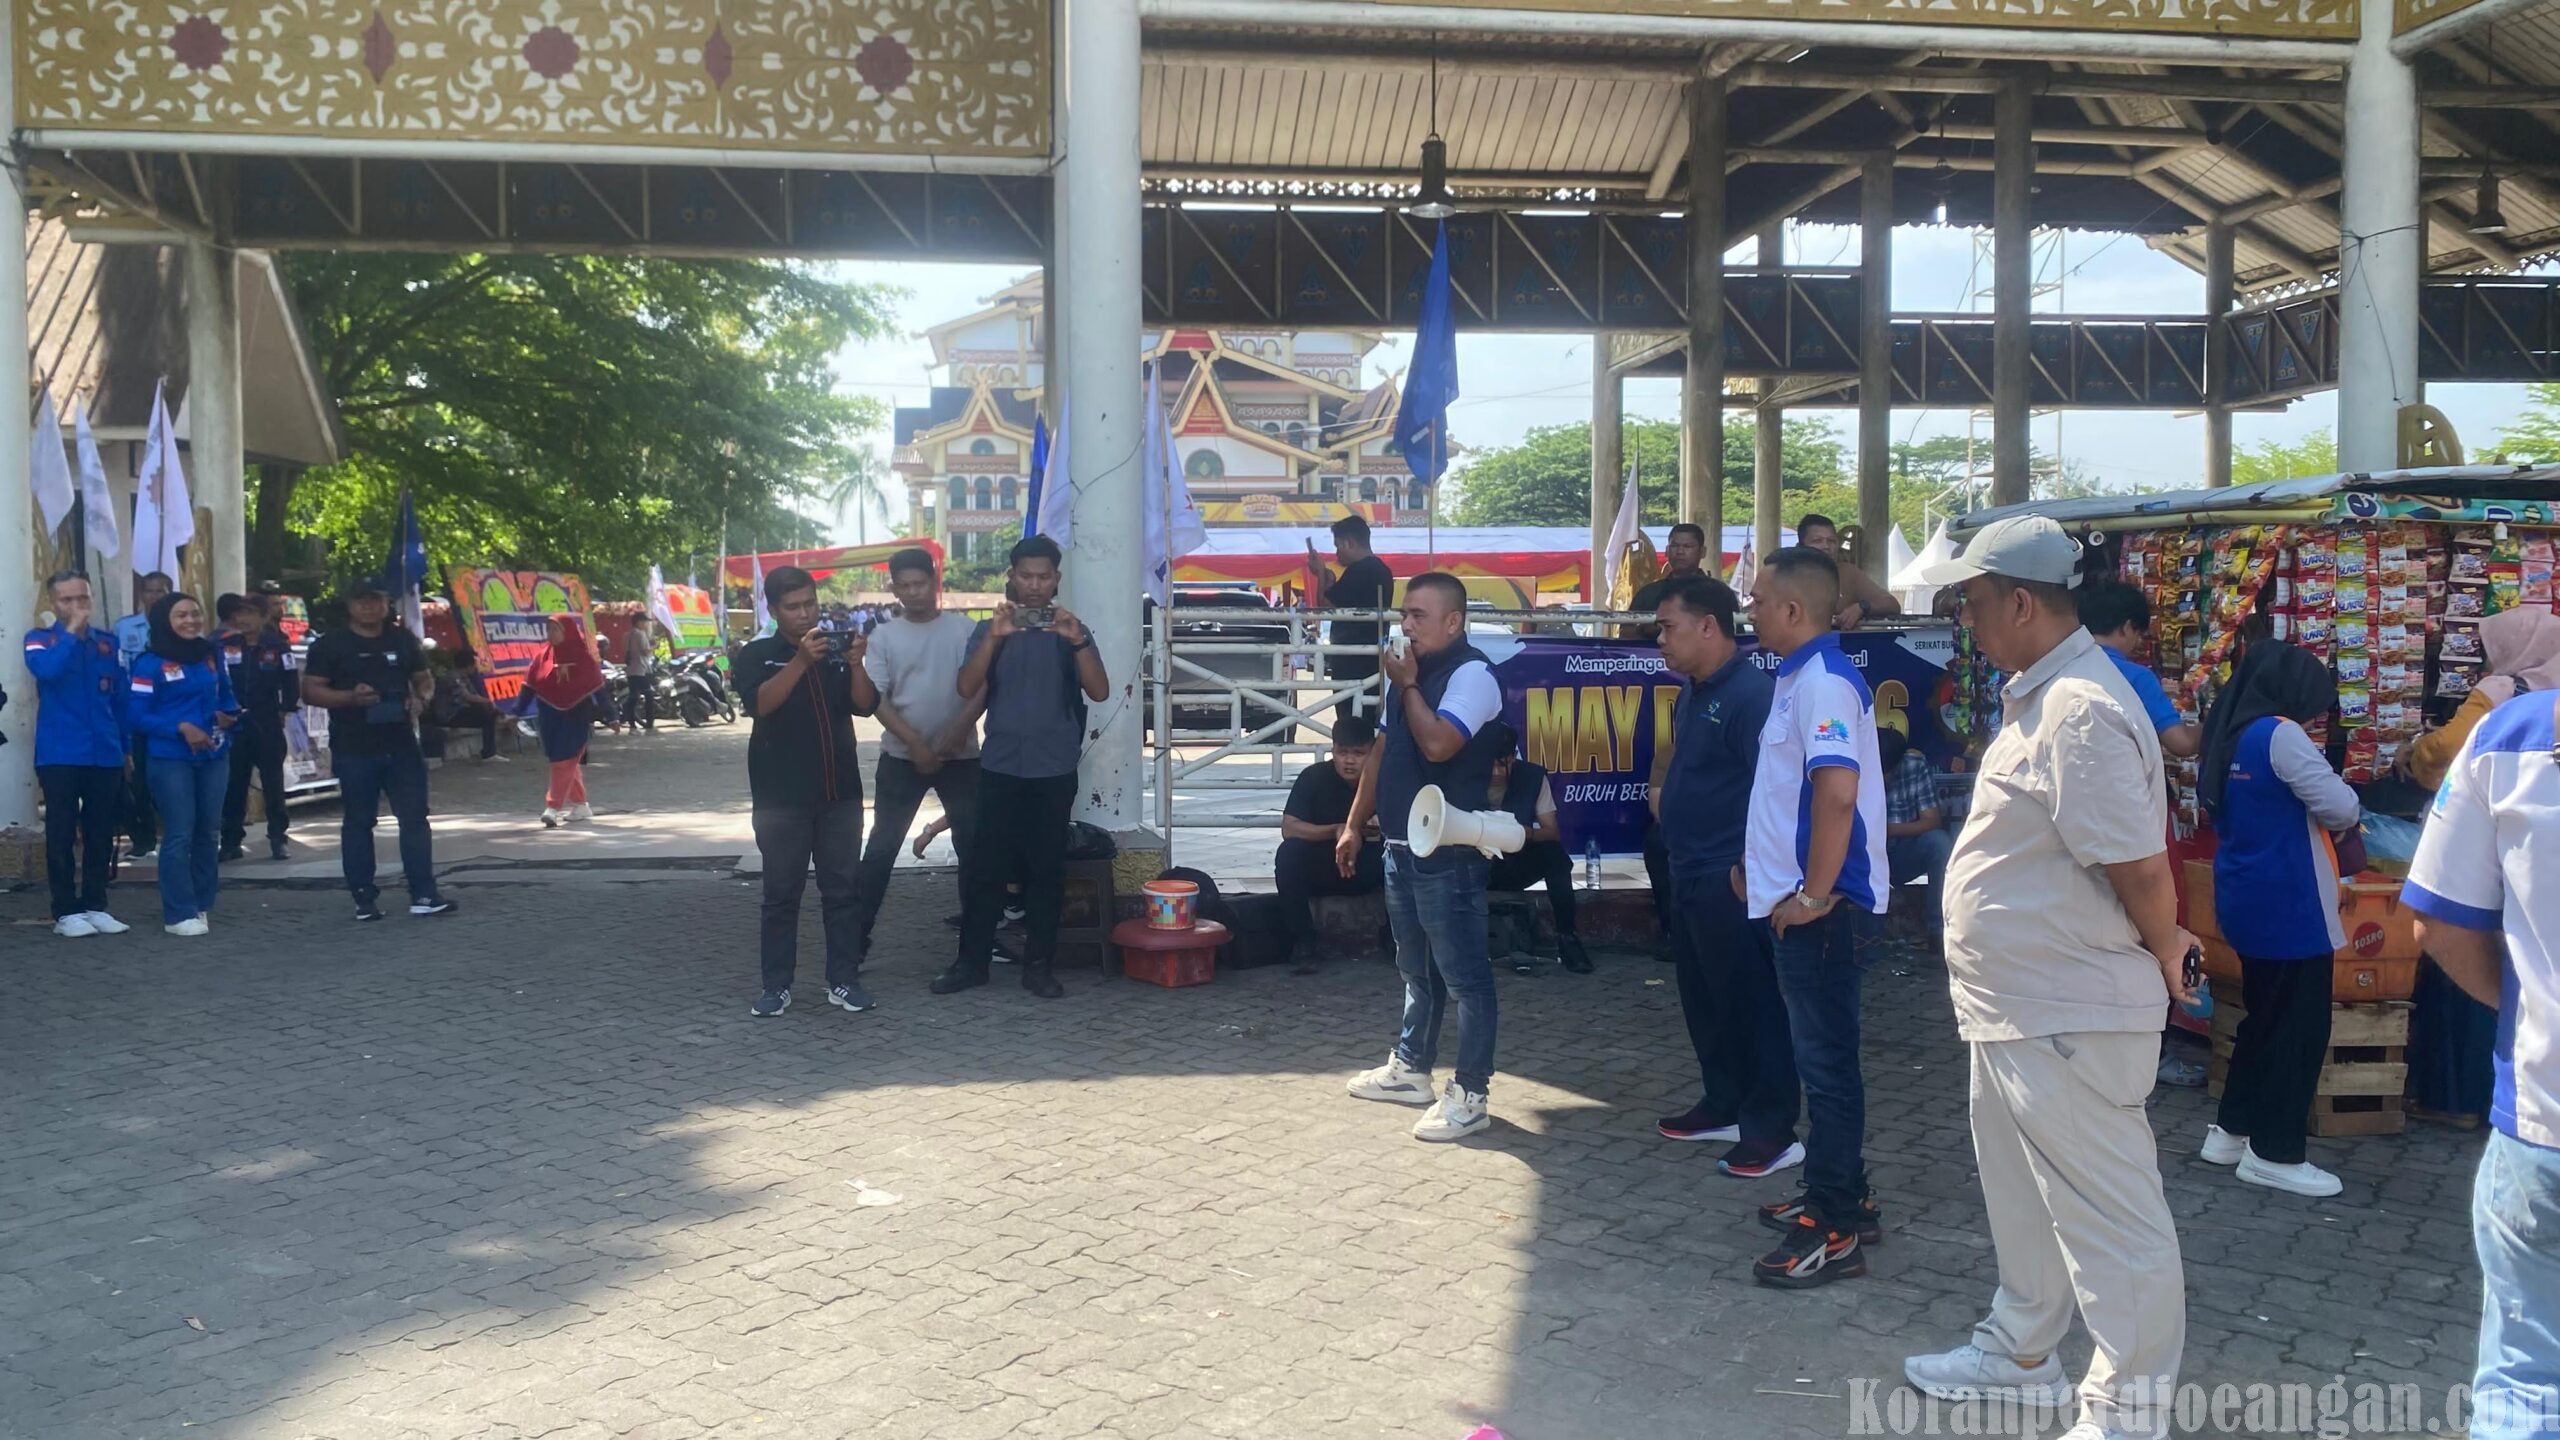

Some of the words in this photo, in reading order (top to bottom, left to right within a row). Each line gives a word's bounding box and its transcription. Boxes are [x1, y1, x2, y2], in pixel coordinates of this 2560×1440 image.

[1914, 640, 1941, 650] SERIKAT
[1565, 653, 1671, 675] Memperinga
[1526, 685, 1642, 774] MAY
[1564, 783, 1618, 803] BURUH
[1620, 782, 1649, 802] BER
[2354, 929, 2385, 950] SOSRO
